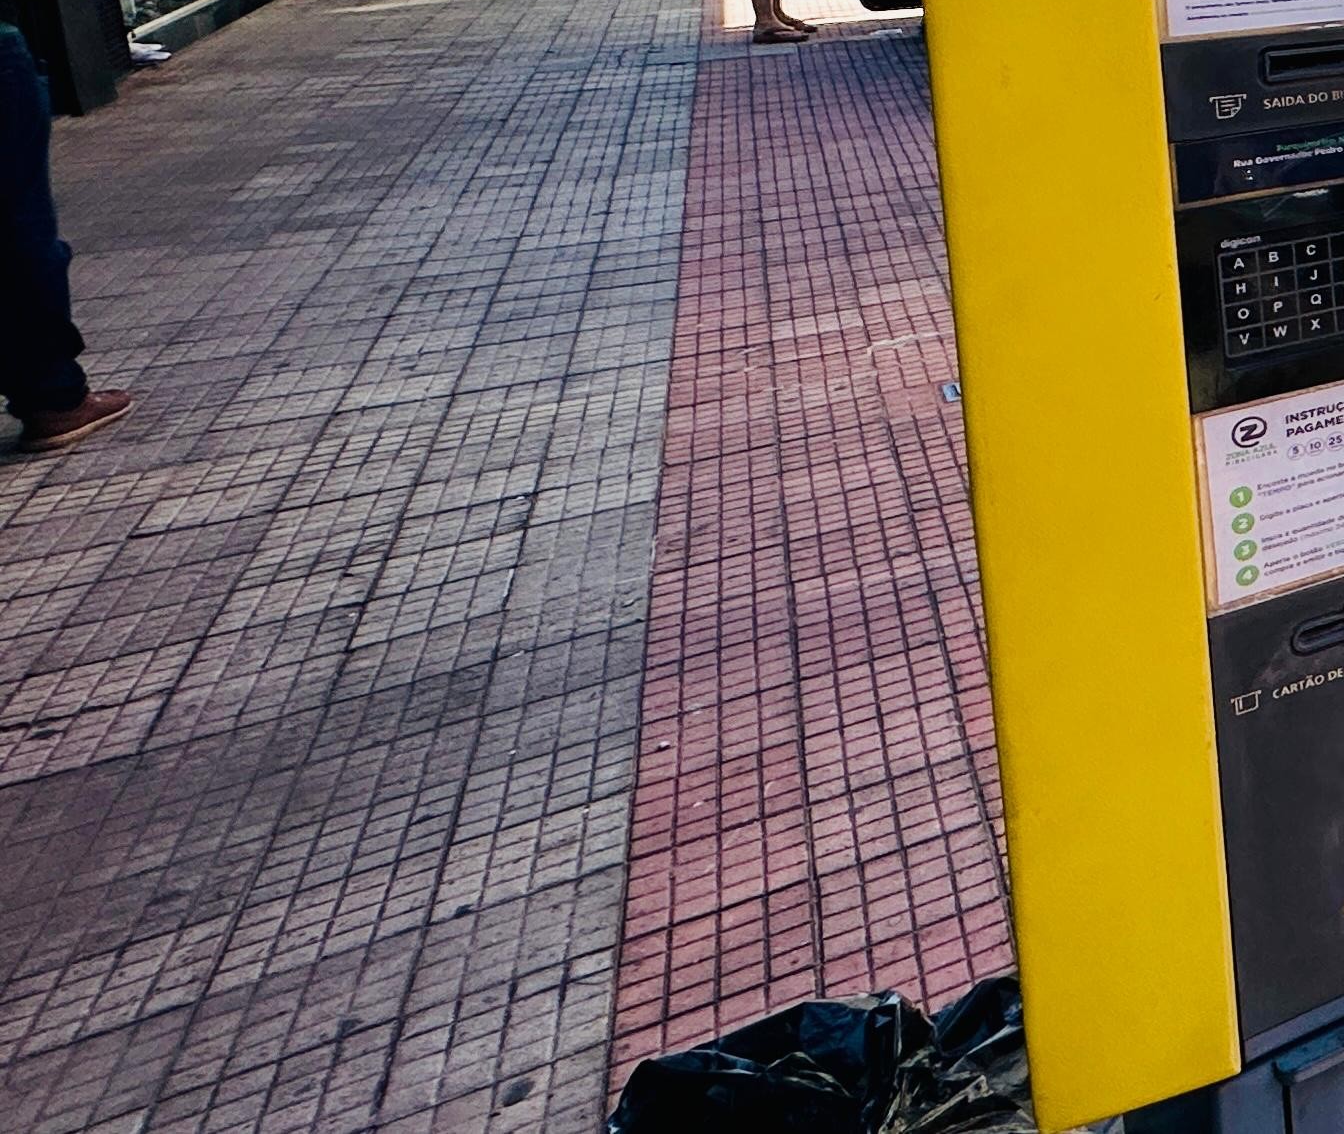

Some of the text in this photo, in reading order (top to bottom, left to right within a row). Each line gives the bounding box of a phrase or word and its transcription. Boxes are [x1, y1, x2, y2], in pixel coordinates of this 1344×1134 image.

[1263, 94, 1305, 110] SAIDA
[1308, 91, 1329, 105] DO
[1233, 159, 1254, 168] Rua
[1314, 145, 1344, 156] Pedro
[1220, 235, 1261, 249] digicon
[1233, 258, 1245, 270] A
[1269, 252, 1279, 262] B
[1306, 244, 1316, 255] C
[1236, 283, 1247, 294] H
[1274, 276, 1279, 287] I
[1310, 269, 1318, 280] J
[1238, 308, 1249, 319] O
[1273, 301, 1283, 312] P
[1310, 294, 1322, 305] Q
[1240, 333, 1250, 345] V
[1273, 325, 1288, 338] W
[1311, 319, 1320, 330] X
[1310, 441, 1322, 450] 10
[1328, 435, 1343, 446] 25
[1237, 491, 1245, 503] 1
[1239, 518, 1248, 530] 2
[1243, 570, 1252, 582] 4
[1272, 674, 1325, 700] CARTÃO
[1328, 667, 1344, 682] DE
